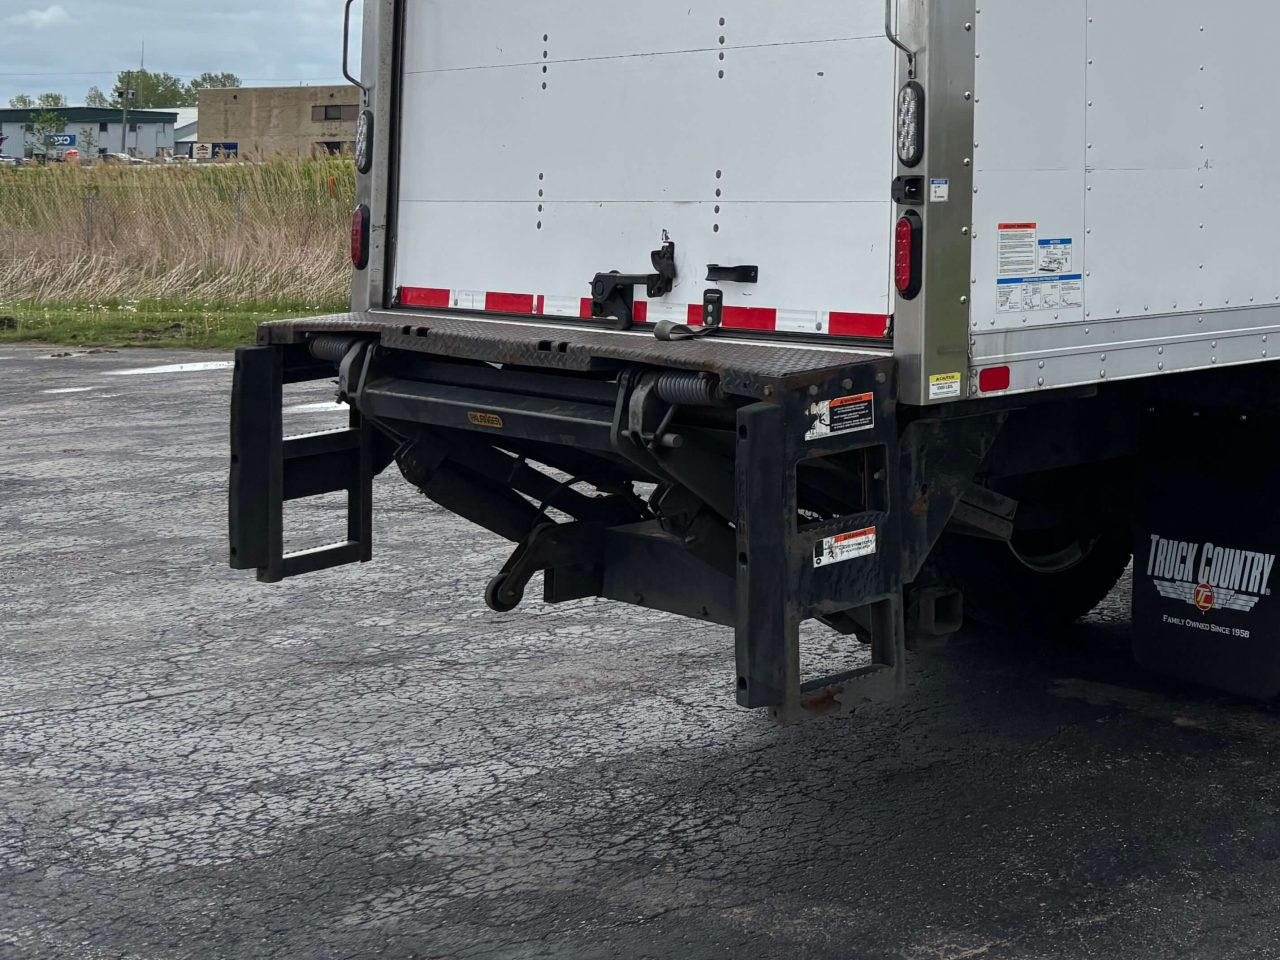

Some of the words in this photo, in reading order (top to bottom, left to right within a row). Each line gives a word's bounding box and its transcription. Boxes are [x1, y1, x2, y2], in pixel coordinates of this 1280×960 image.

[1147, 534, 1198, 582] TRUCK
[1198, 542, 1275, 595] COUNTRY
[1163, 614, 1186, 626] FAMILY
[1185, 619, 1210, 631] OWNED
[1210, 623, 1230, 635] SINCE
[1232, 628, 1250, 638] 1958
